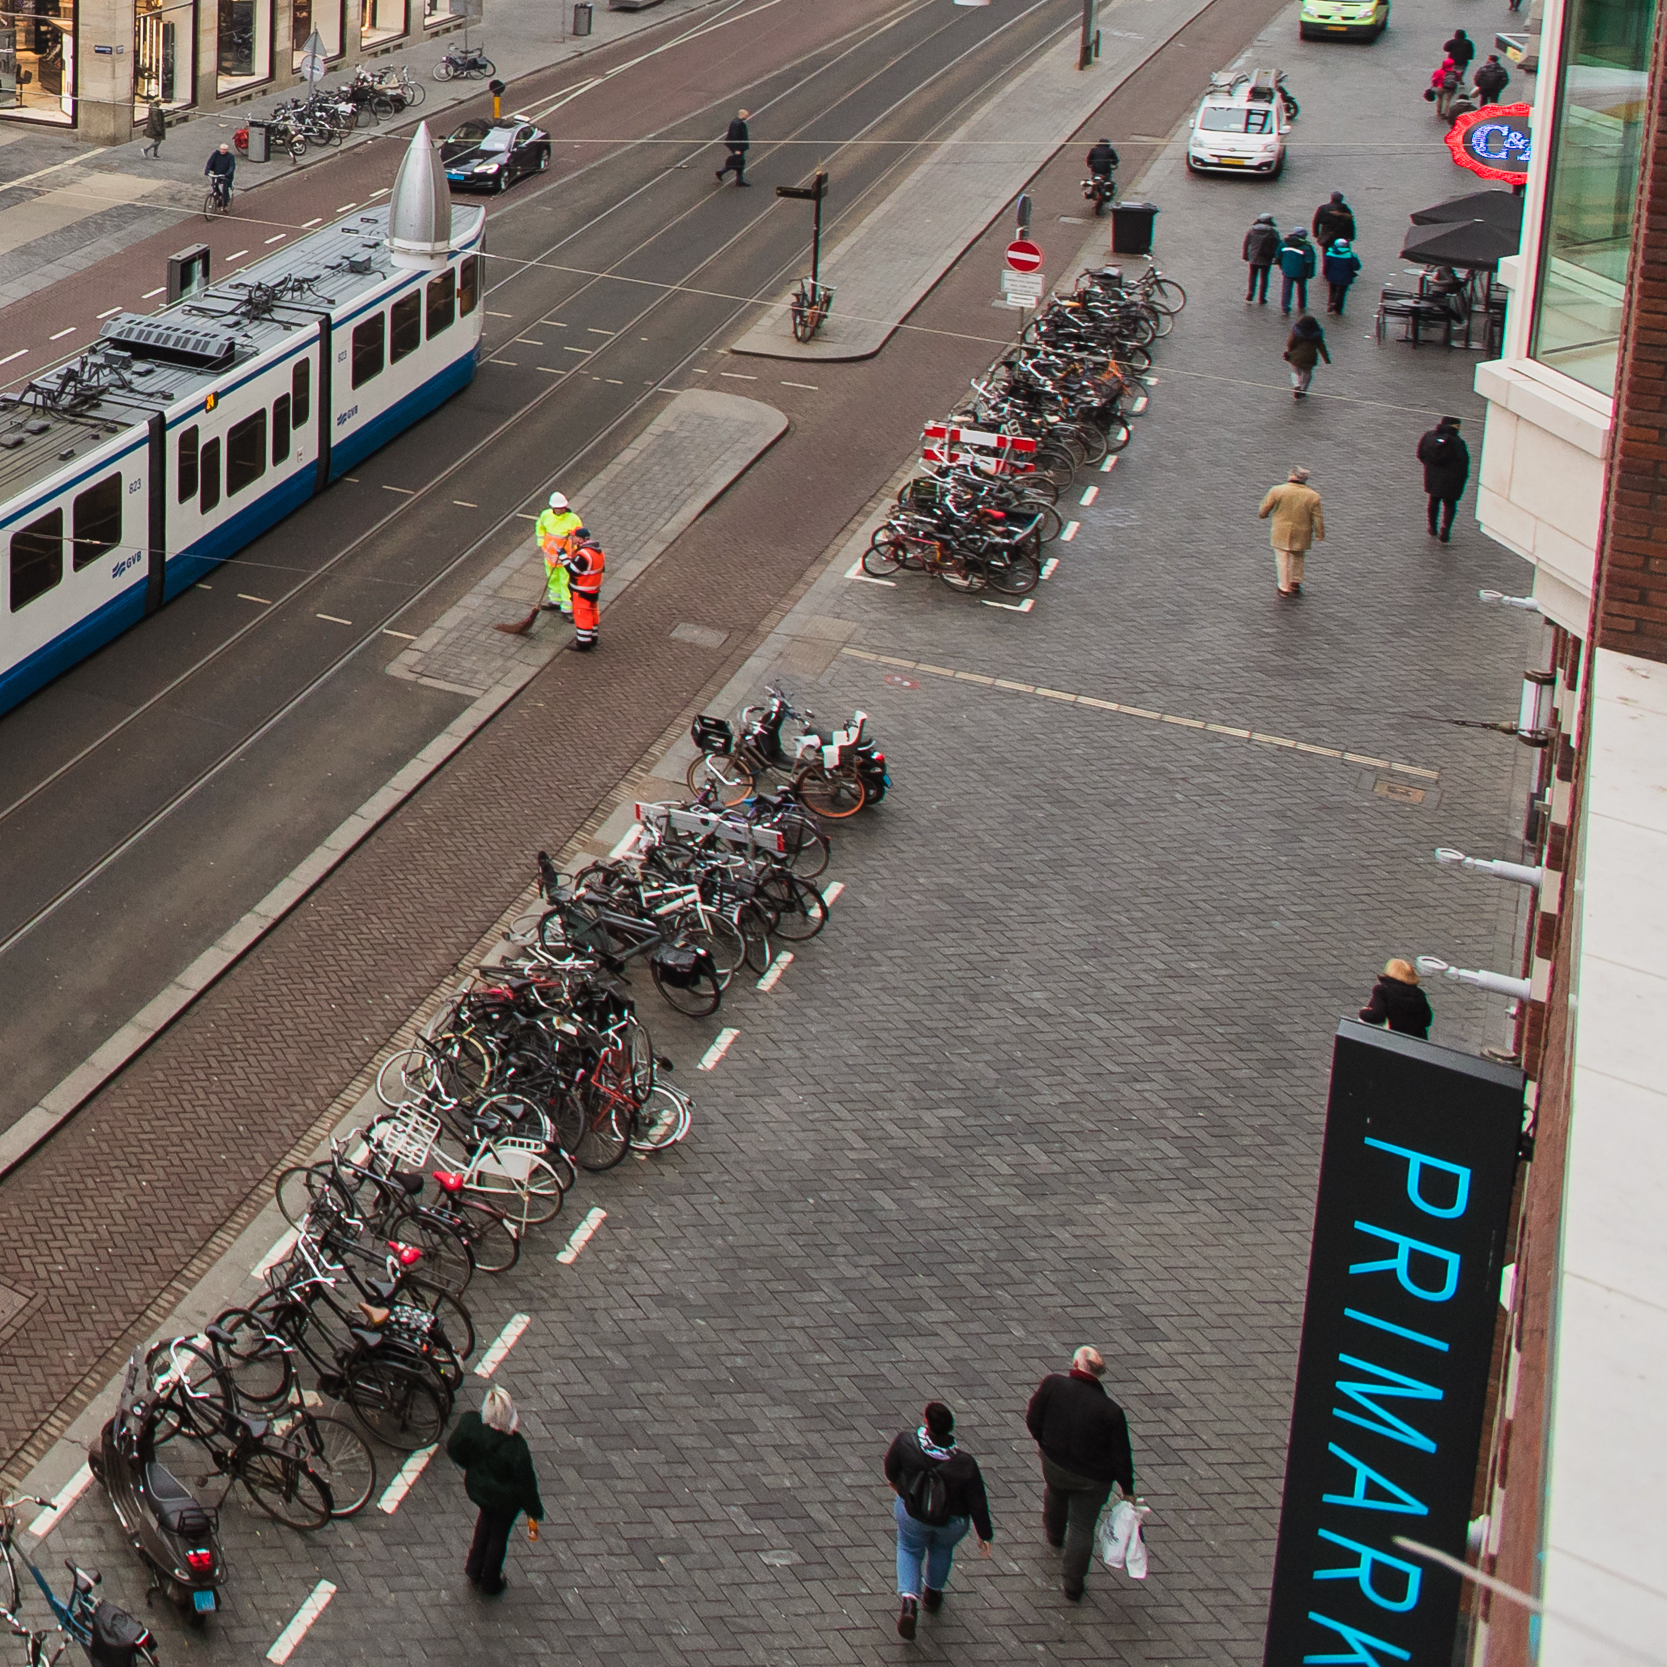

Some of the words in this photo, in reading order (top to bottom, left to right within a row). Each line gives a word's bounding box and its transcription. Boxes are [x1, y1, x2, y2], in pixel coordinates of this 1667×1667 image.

[128, 477, 142, 495] 823
[126, 550, 142, 569] GVB
[1301, 1135, 1472, 1667] PRIMARK
